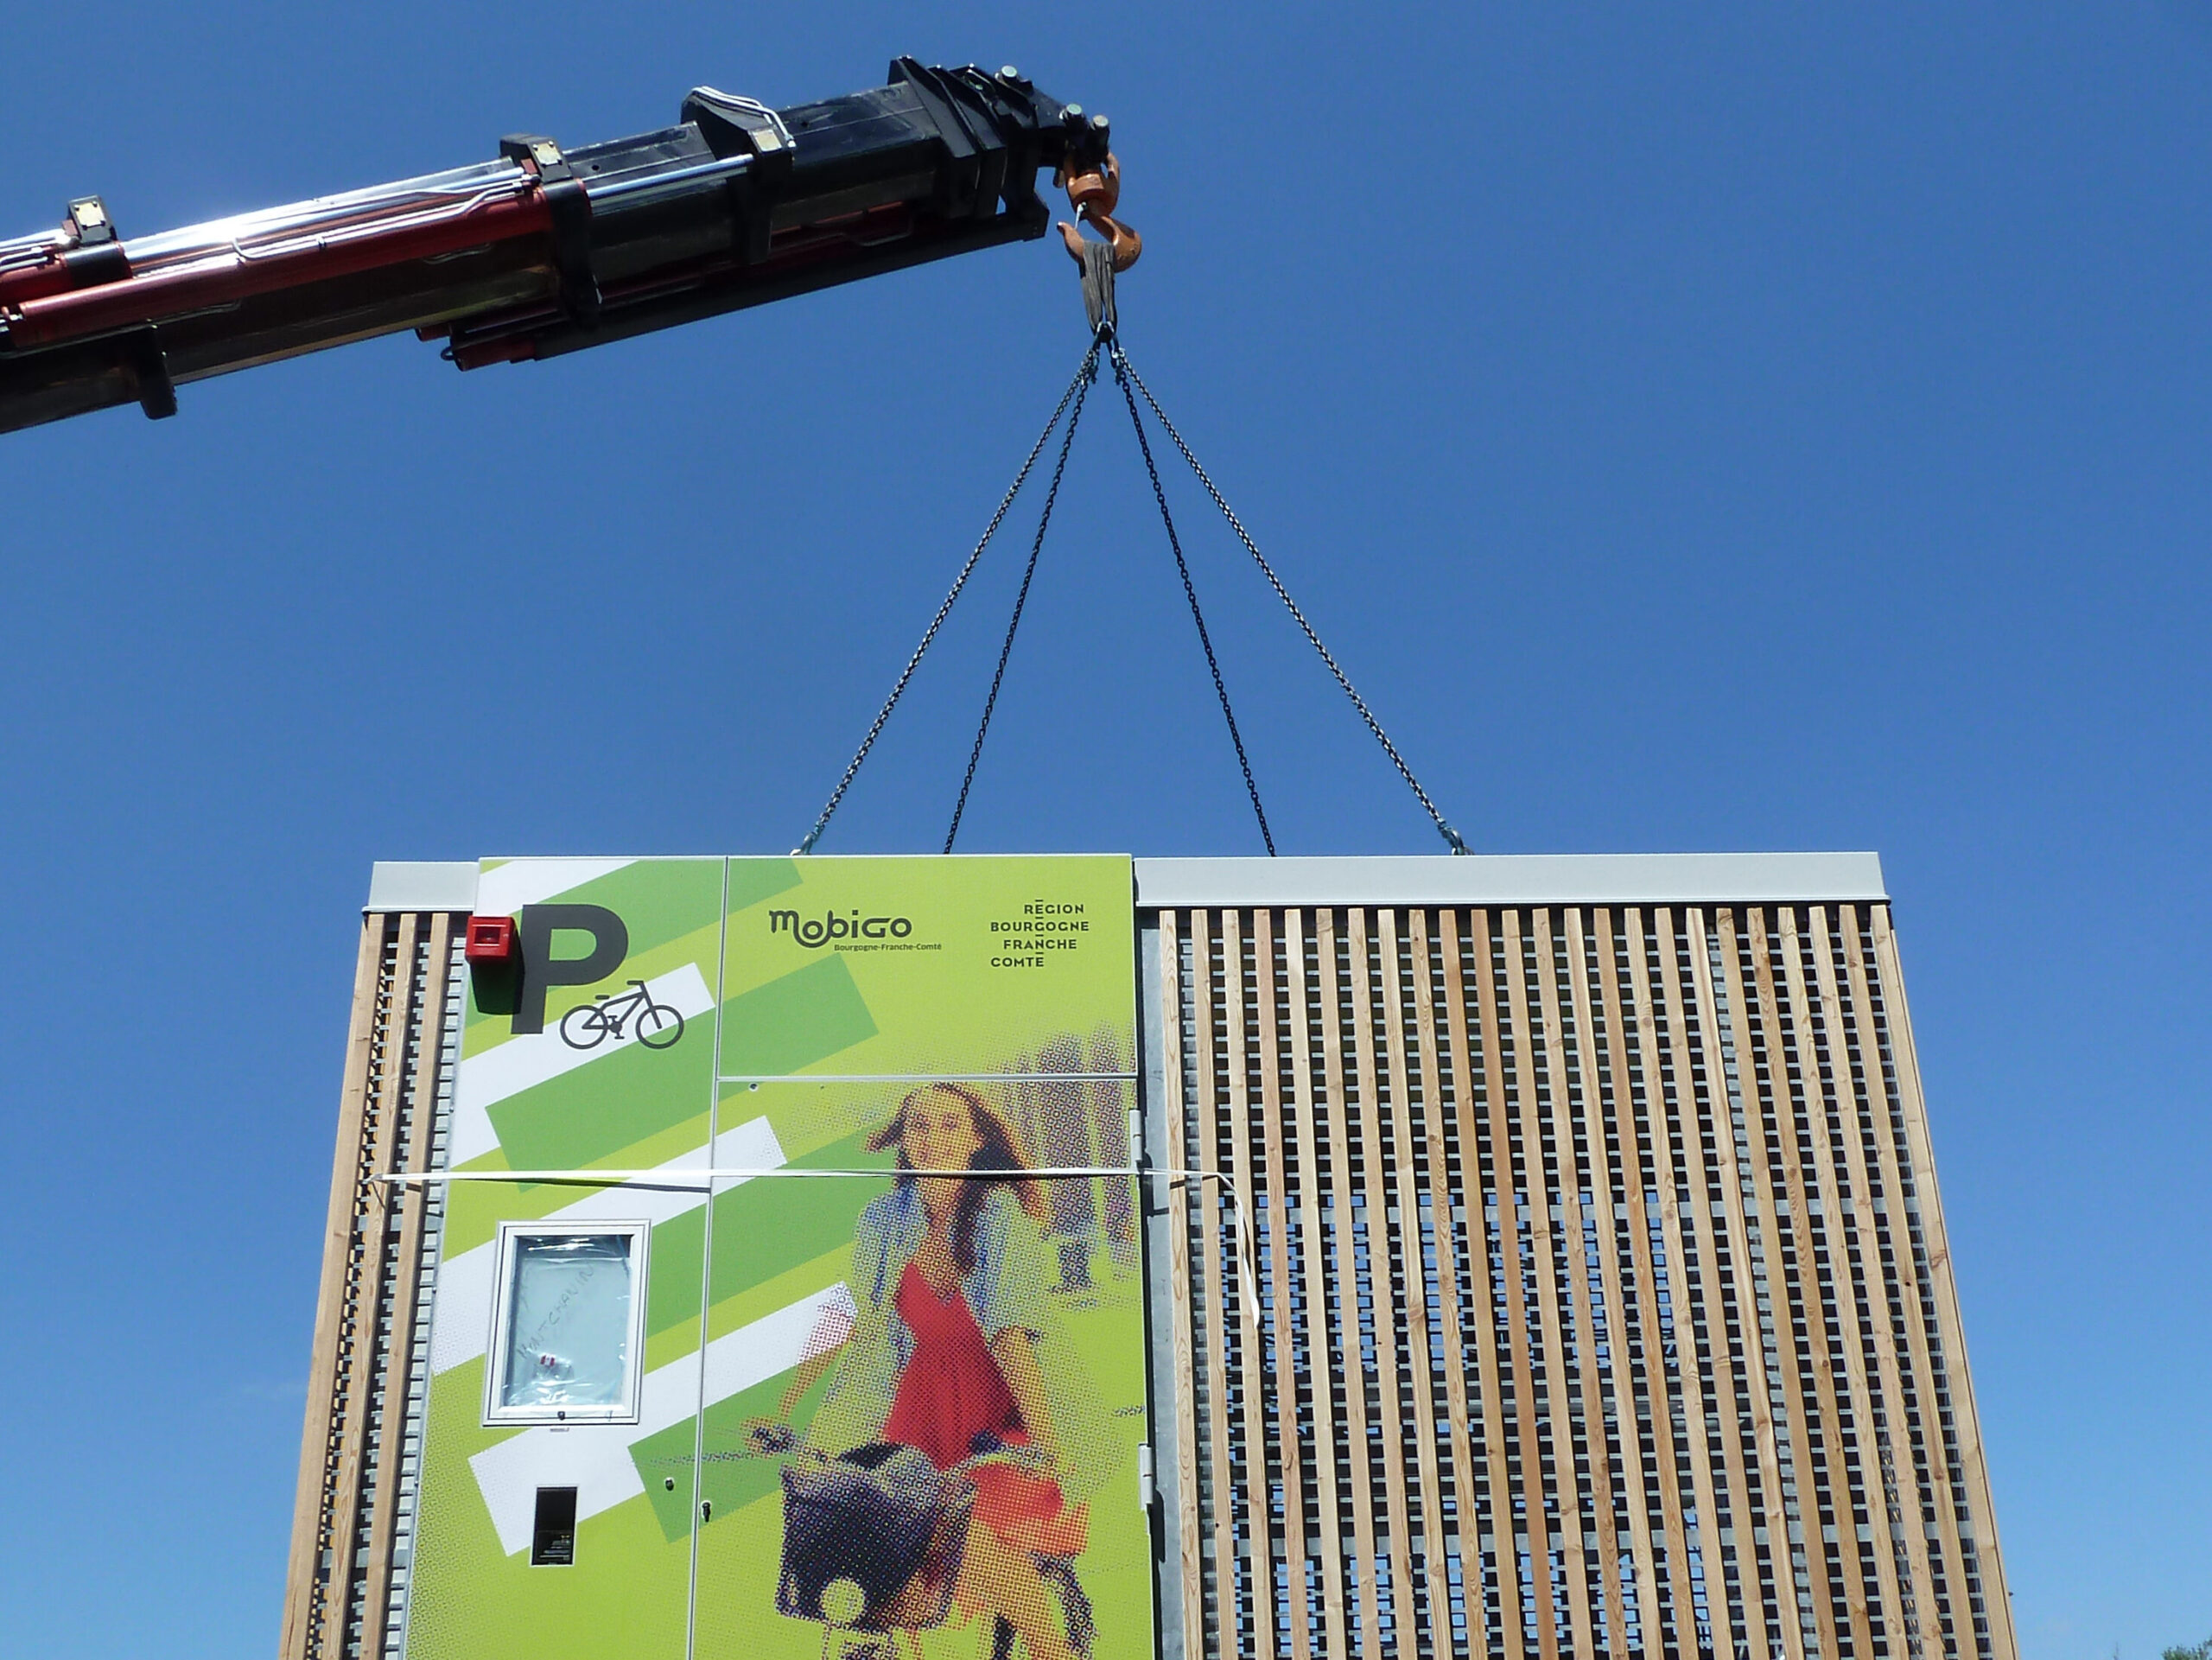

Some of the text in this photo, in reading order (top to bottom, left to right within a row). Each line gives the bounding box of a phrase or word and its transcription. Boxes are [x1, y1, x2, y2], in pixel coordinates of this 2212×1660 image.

[990, 921, 1090, 932] BOURGOGNE
[834, 943, 942, 951] Bourgogne-Franche-Comté
[1003, 938, 1077, 950] FRANCHE
[510, 904, 629, 1034] P
